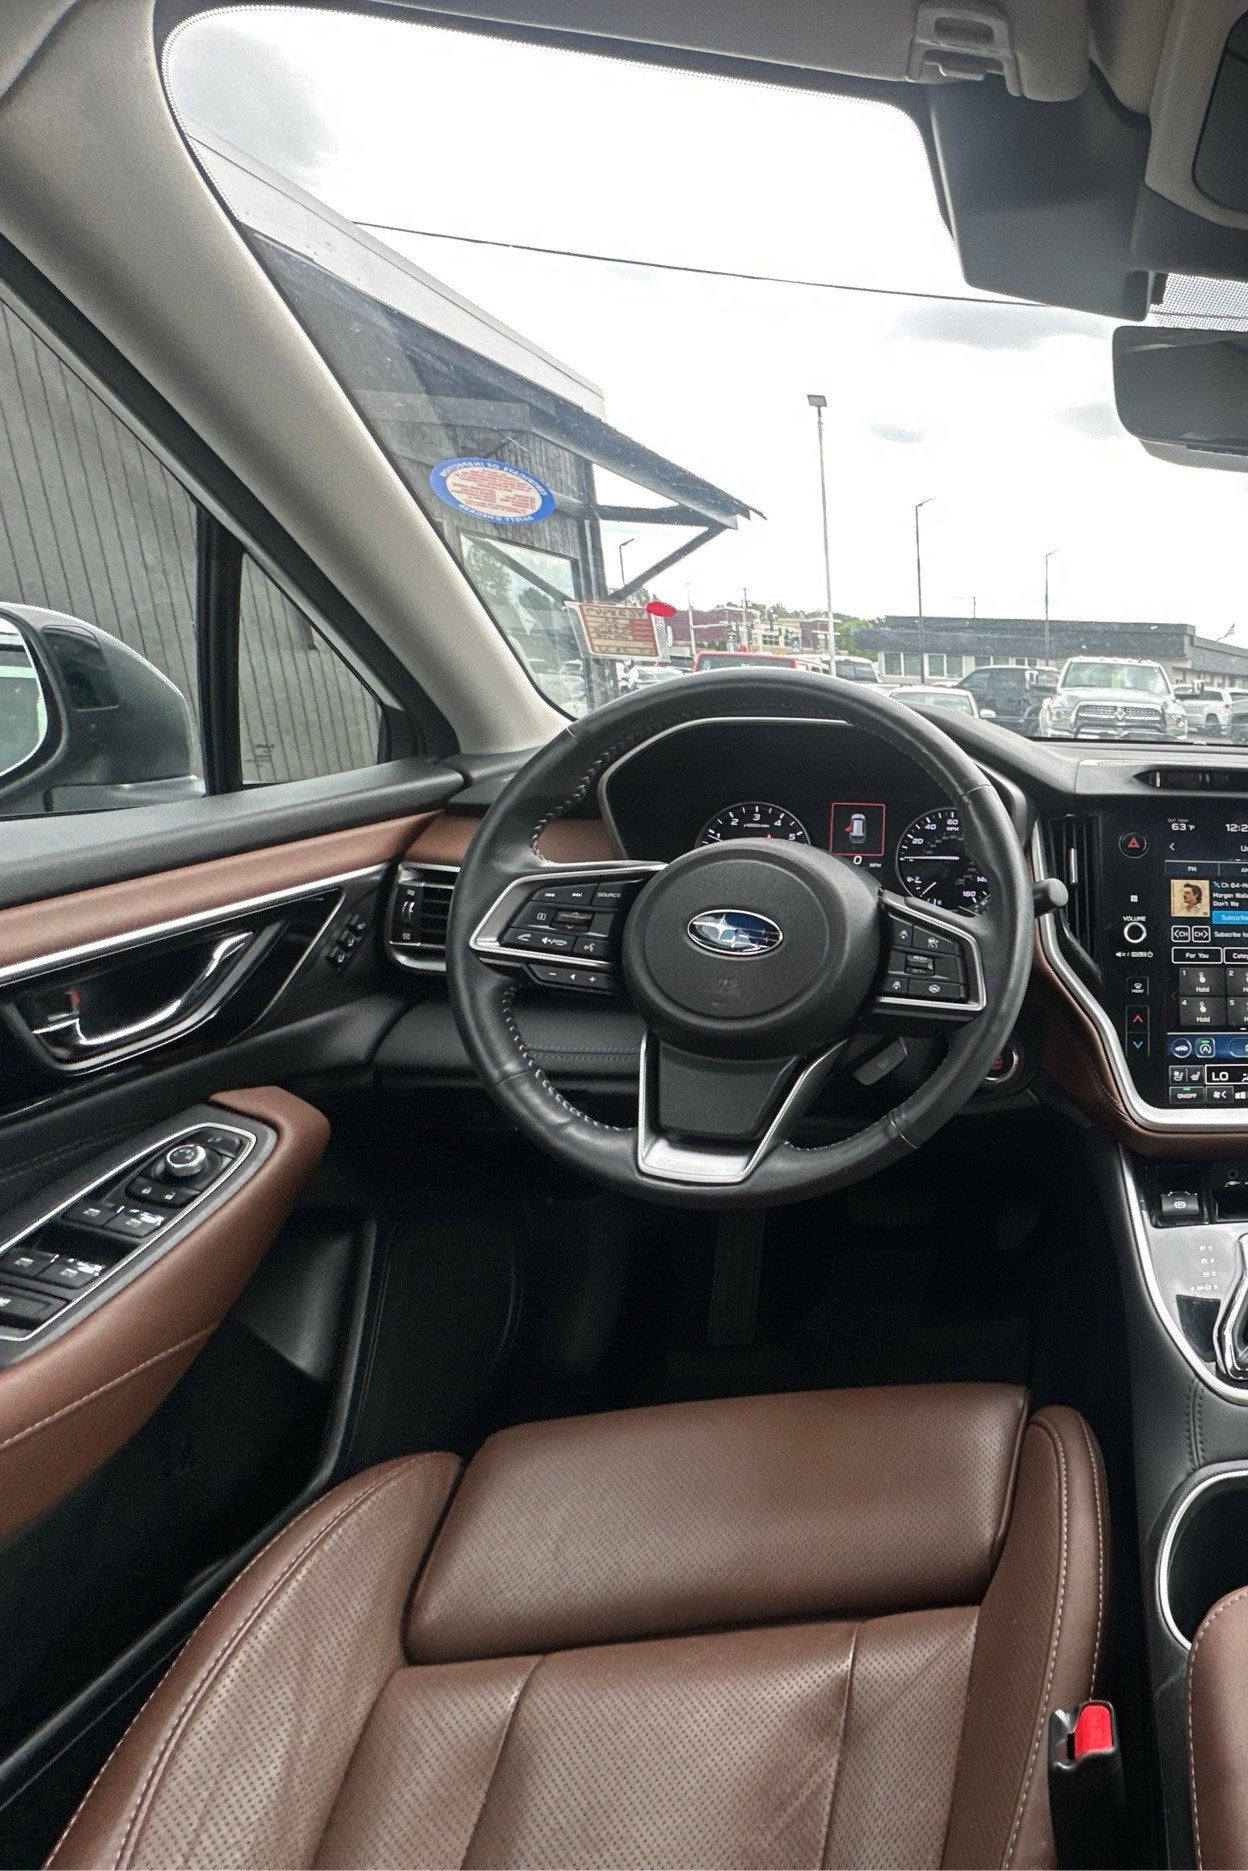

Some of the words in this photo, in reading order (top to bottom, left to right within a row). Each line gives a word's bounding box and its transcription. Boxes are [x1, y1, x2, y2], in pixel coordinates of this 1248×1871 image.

[731, 818, 739, 826] 2
[774, 819, 782, 827] 4
[853, 855, 862, 865] 0
[1212, 892, 1234, 900] Morgan
[1212, 1071, 1229, 1081] LO
